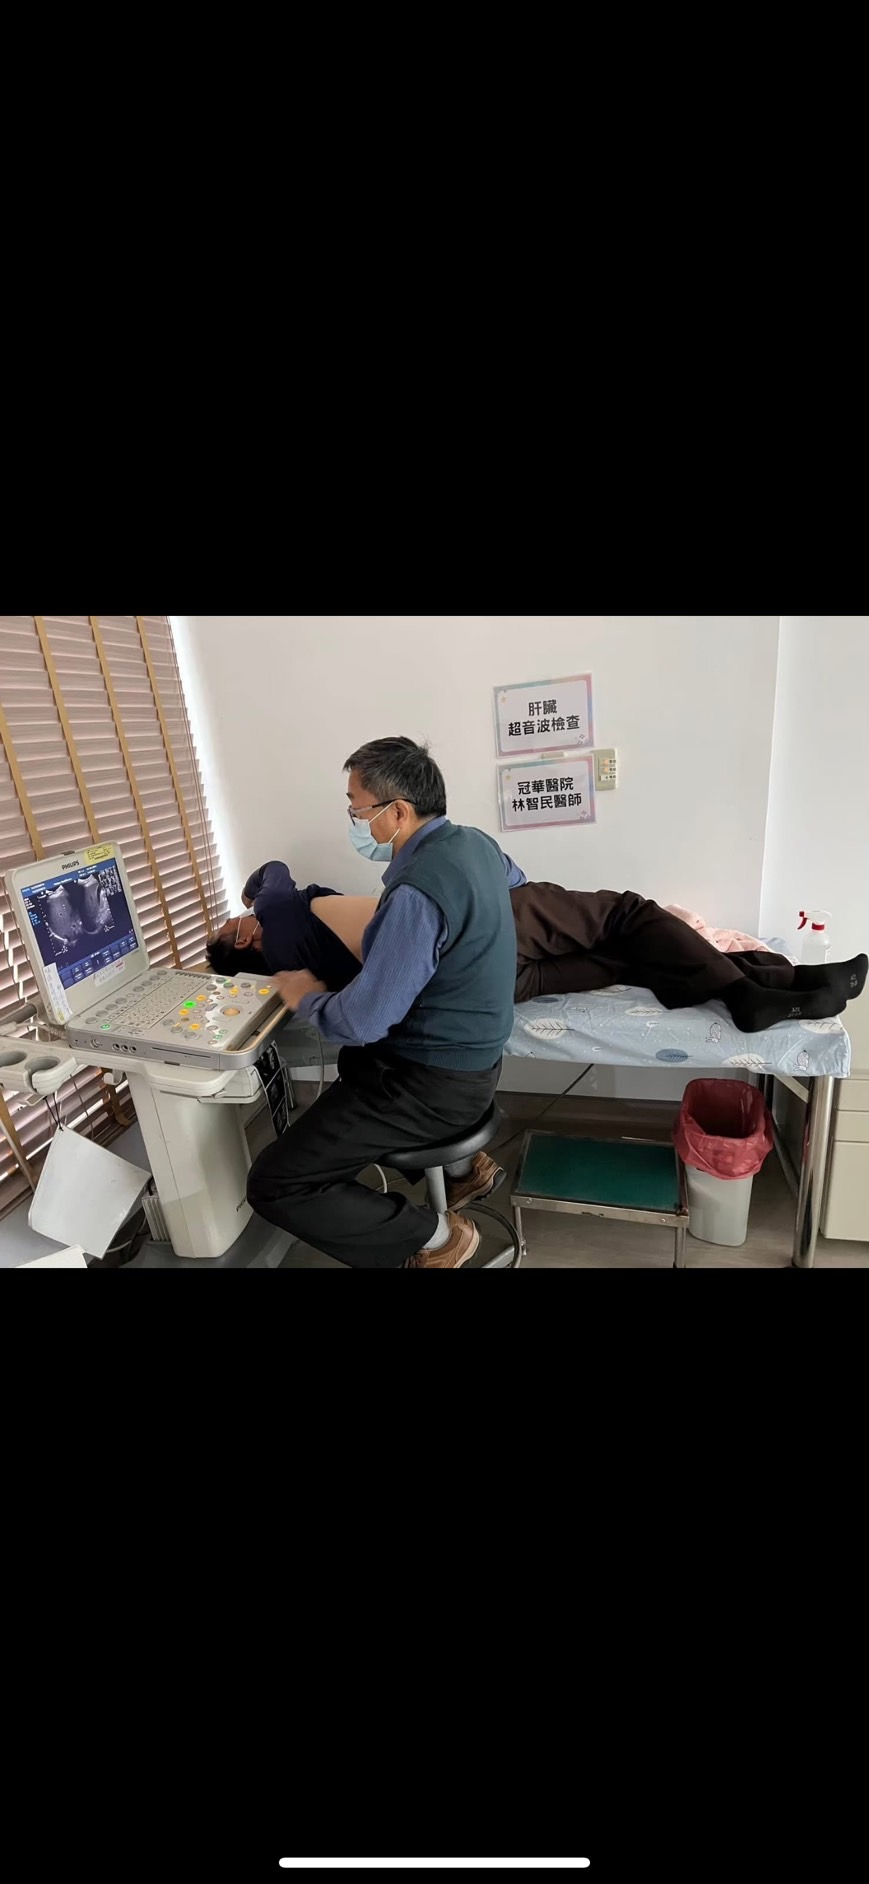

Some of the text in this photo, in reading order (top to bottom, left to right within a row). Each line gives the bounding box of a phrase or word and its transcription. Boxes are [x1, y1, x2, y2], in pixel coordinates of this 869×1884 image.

[528, 699, 557, 716] 肝臟
[508, 715, 580, 736] 超音波檢查
[518, 777, 574, 795] 冠華醫院
[512, 793, 582, 812] 林智民醫師
[62, 860, 80, 870] PHILIPS
